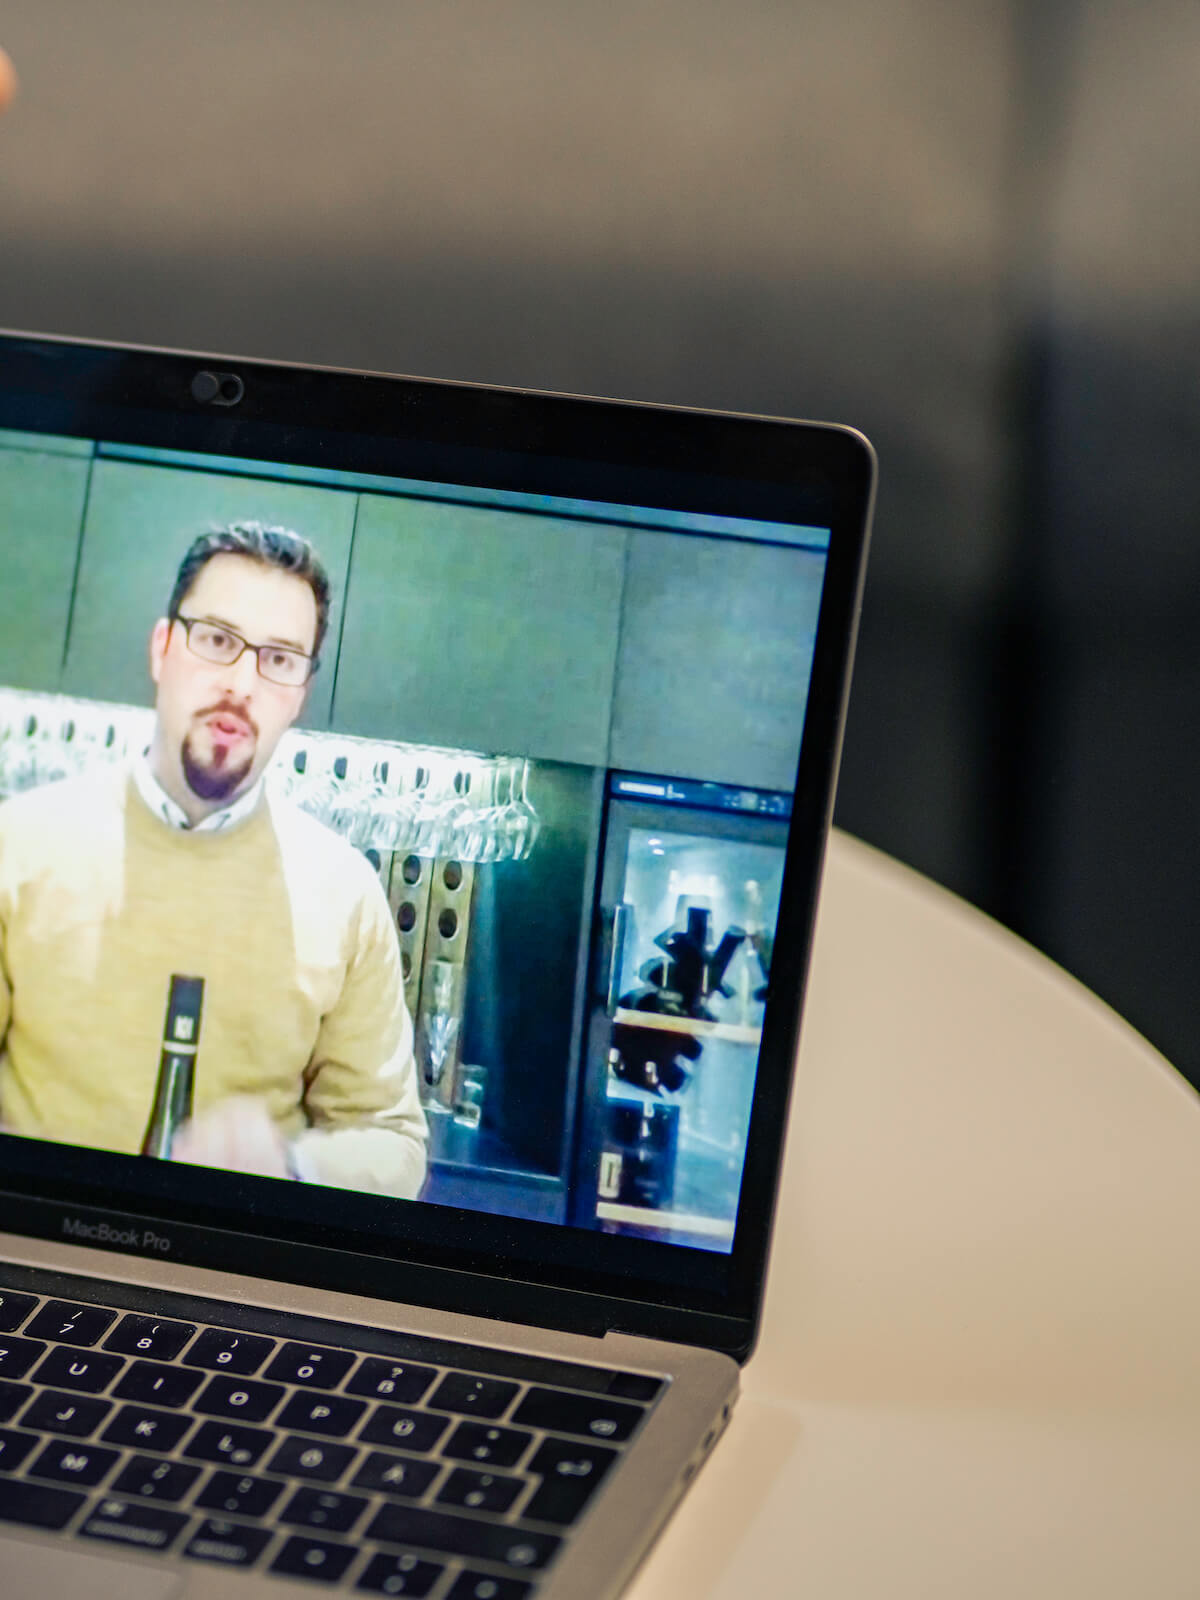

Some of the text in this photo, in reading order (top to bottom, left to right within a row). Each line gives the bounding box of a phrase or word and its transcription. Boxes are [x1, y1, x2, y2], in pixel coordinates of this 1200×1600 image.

[62, 1217, 171, 1250] MacBook Pro
[59, 1323, 75, 1334] 7
[136, 1337, 153, 1349] 8
[216, 1351, 233, 1364] 9
[69, 1362, 88, 1376] U
[56, 1407, 76, 1421] J
[135, 1420, 157, 1435] K
